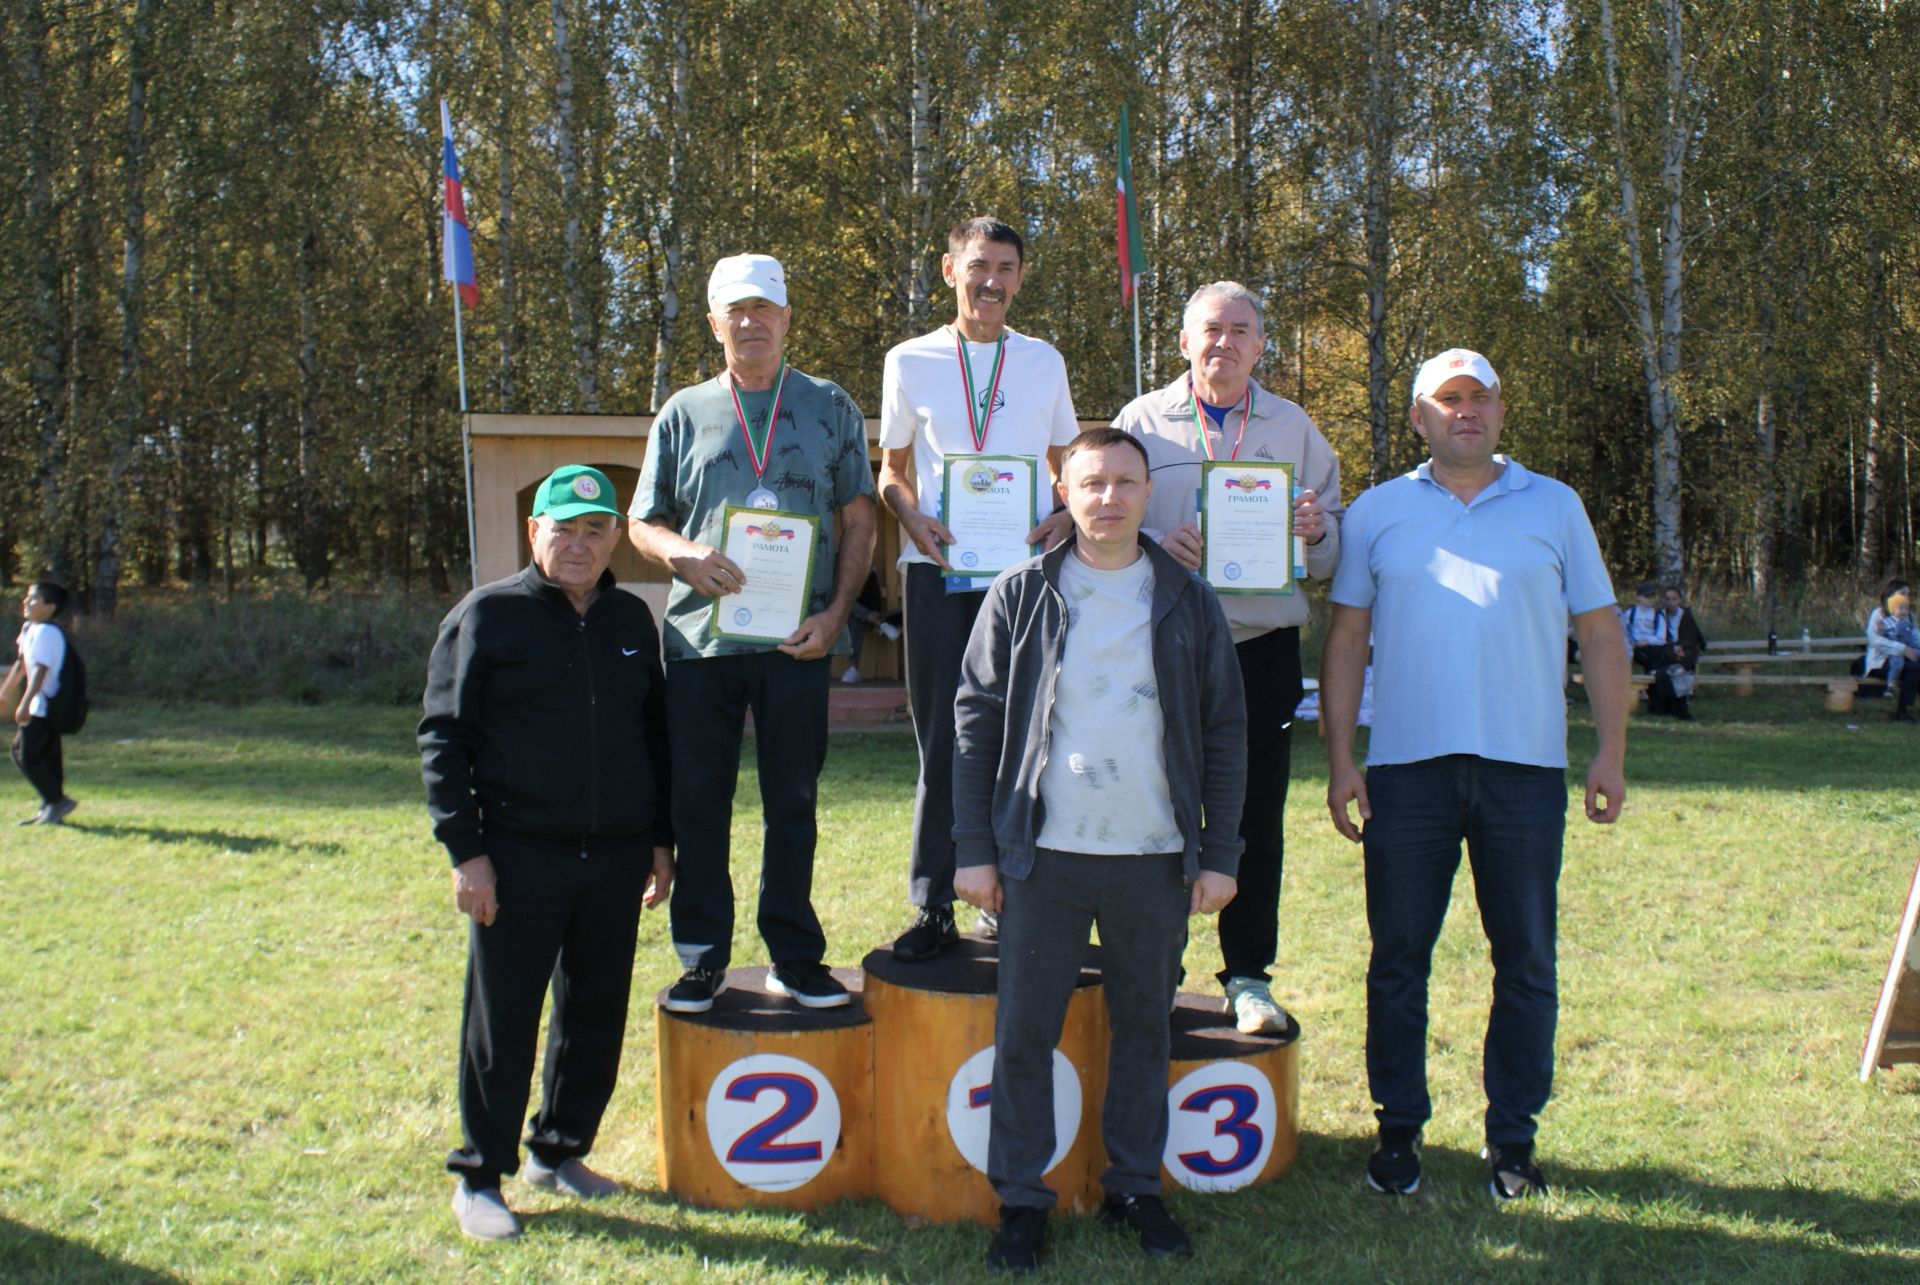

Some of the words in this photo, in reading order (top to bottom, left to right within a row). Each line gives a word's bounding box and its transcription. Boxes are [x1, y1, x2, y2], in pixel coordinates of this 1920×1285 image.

[1228, 495, 1269, 503] ГРАМОТА
[724, 1072, 823, 1164] 2
[1178, 1084, 1263, 1177] 3
